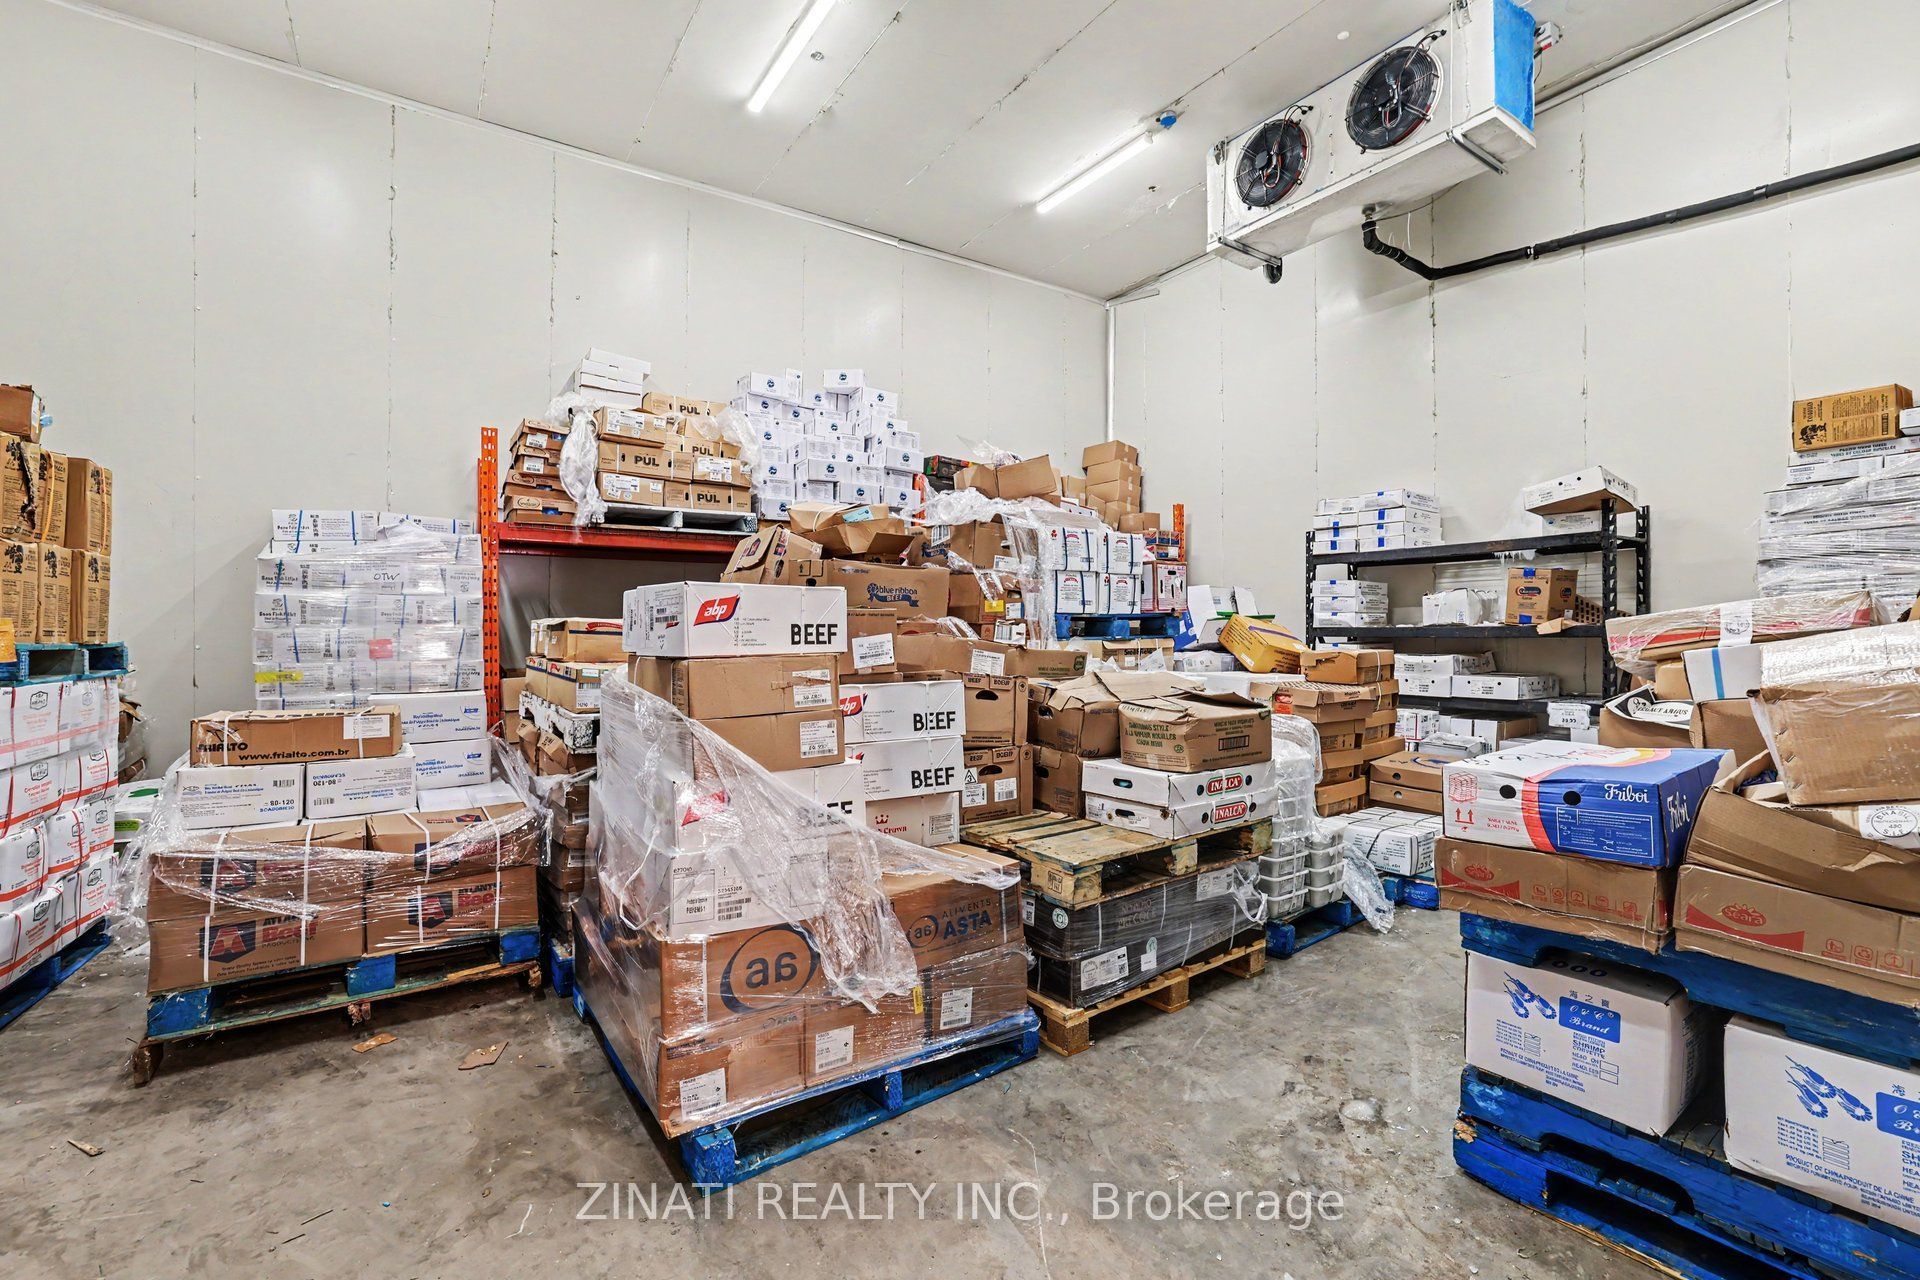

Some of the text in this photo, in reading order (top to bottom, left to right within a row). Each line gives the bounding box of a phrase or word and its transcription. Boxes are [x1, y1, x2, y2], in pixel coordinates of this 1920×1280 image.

[680, 405, 701, 415] PUL
[634, 455, 660, 467] PUL
[692, 446, 714, 457] PUL
[697, 493, 720, 504] PUL
[879, 585, 918, 595] blue ribbon
[704, 598, 728, 621] abp
[790, 623, 838, 645] BEEF
[913, 711, 956, 732] BEEF
[238, 748, 350, 762] www.frialto.com.br
[911, 767, 955, 789] BEEF
[1604, 783, 1650, 804] Friboi
[1215, 804, 1245, 820] INALCA
[1668, 792, 1690, 832] Friboi
[942, 898, 992, 919] ALIMENTS
[943, 910, 992, 940] ASTA
[1569, 1015, 1611, 1035] Brand
[1572, 1039, 1606, 1053] SHRIMP
[1785, 1153, 1813, 1169] PRODUCT
[1884, 1187, 1892, 1197] LA
[1893, 1190, 1915, 1204] CHINE
